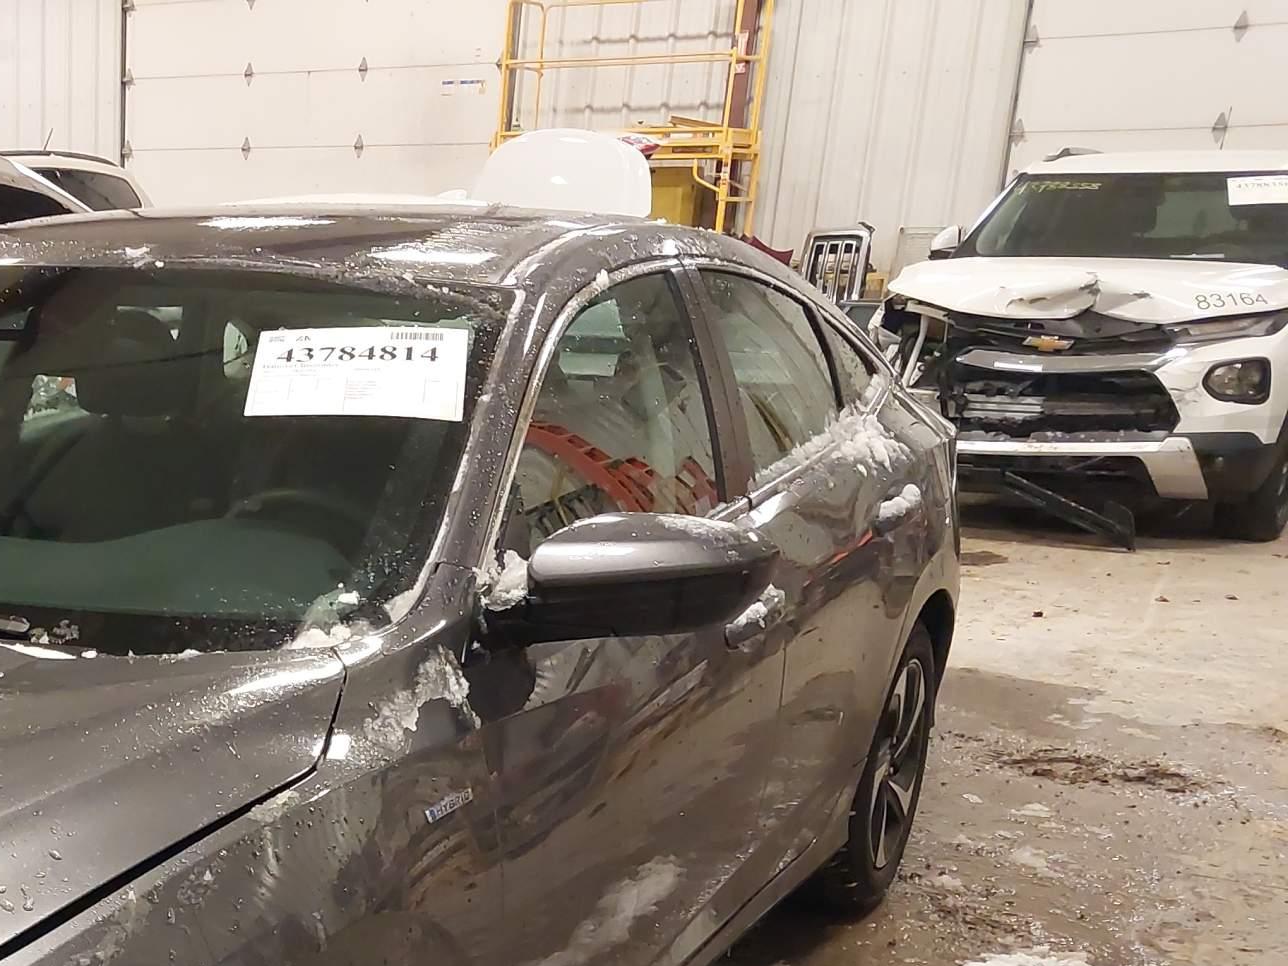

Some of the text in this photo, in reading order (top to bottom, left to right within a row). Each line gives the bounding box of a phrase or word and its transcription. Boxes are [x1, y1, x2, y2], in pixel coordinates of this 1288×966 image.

[1194, 292, 1269, 310] 83164
[276, 345, 439, 363] 43784814
[436, 790, 472, 817] HYBRID
